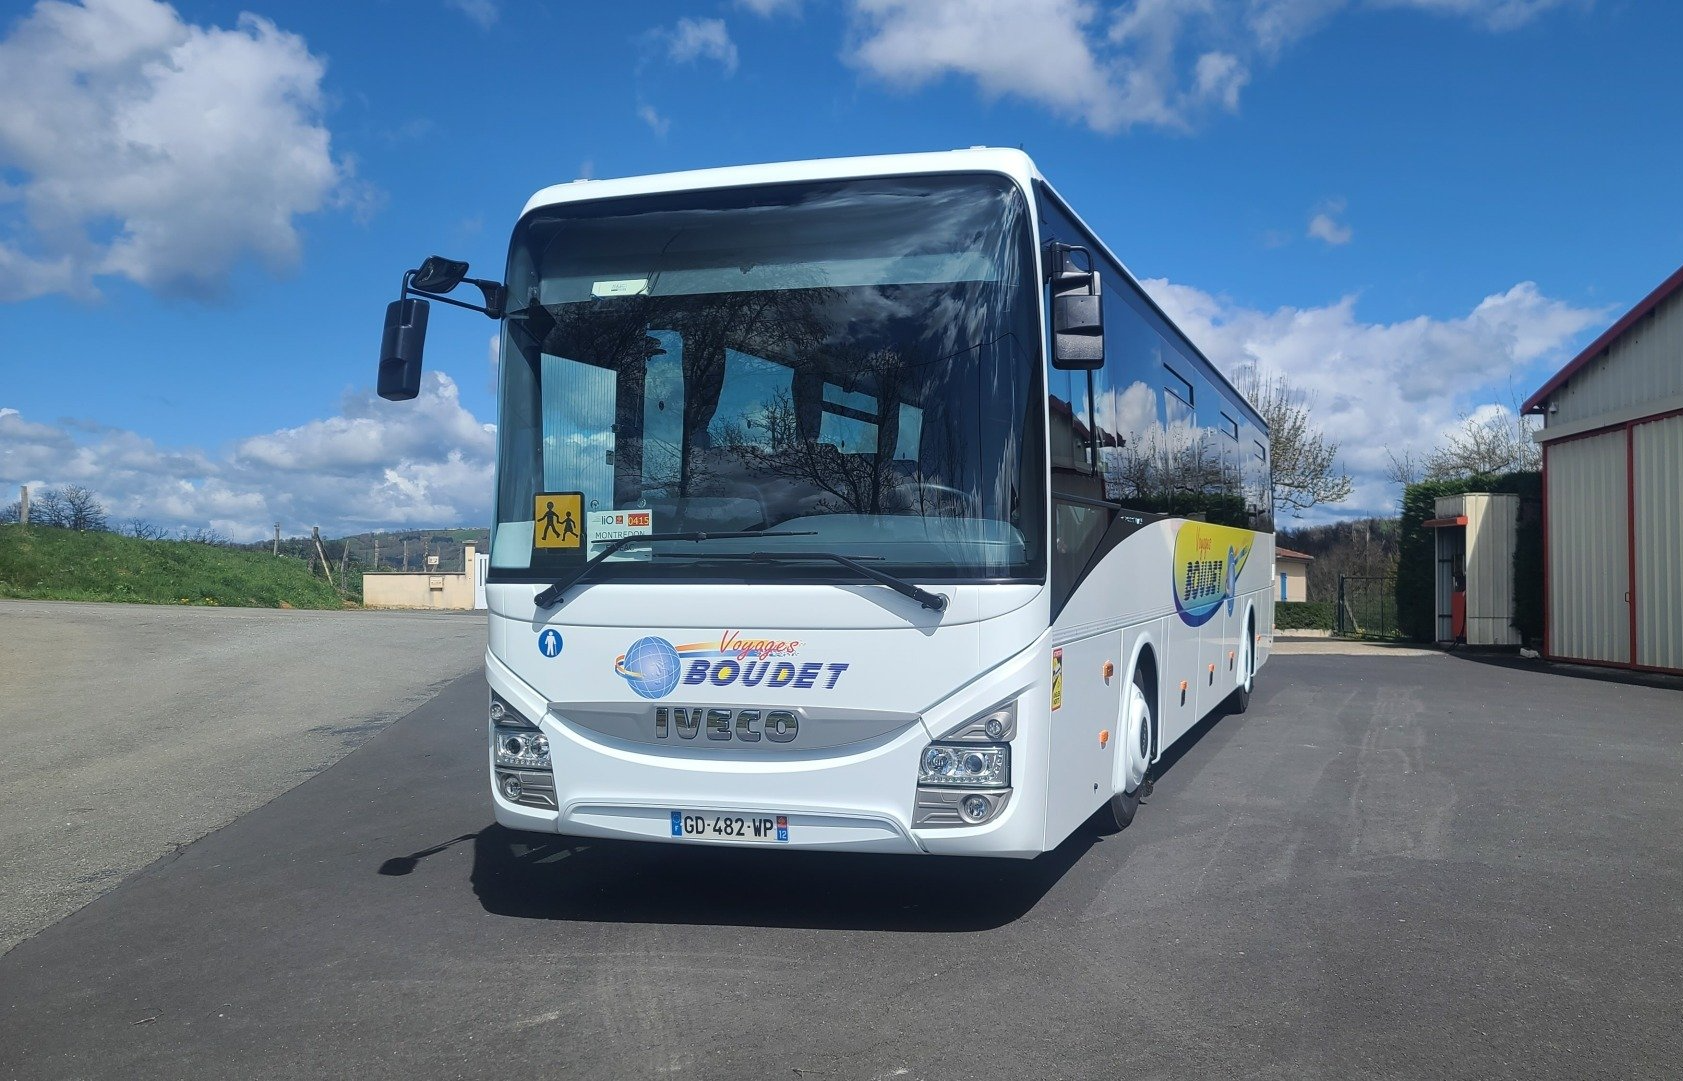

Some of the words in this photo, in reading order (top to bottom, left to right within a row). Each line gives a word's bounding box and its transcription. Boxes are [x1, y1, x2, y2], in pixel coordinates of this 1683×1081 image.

[1183, 560, 1223, 601] BOUDET
[719, 630, 800, 661] Voyages
[682, 659, 850, 689] BOUDET
[655, 706, 799, 743] IVECO
[778, 830, 787, 839] 12
